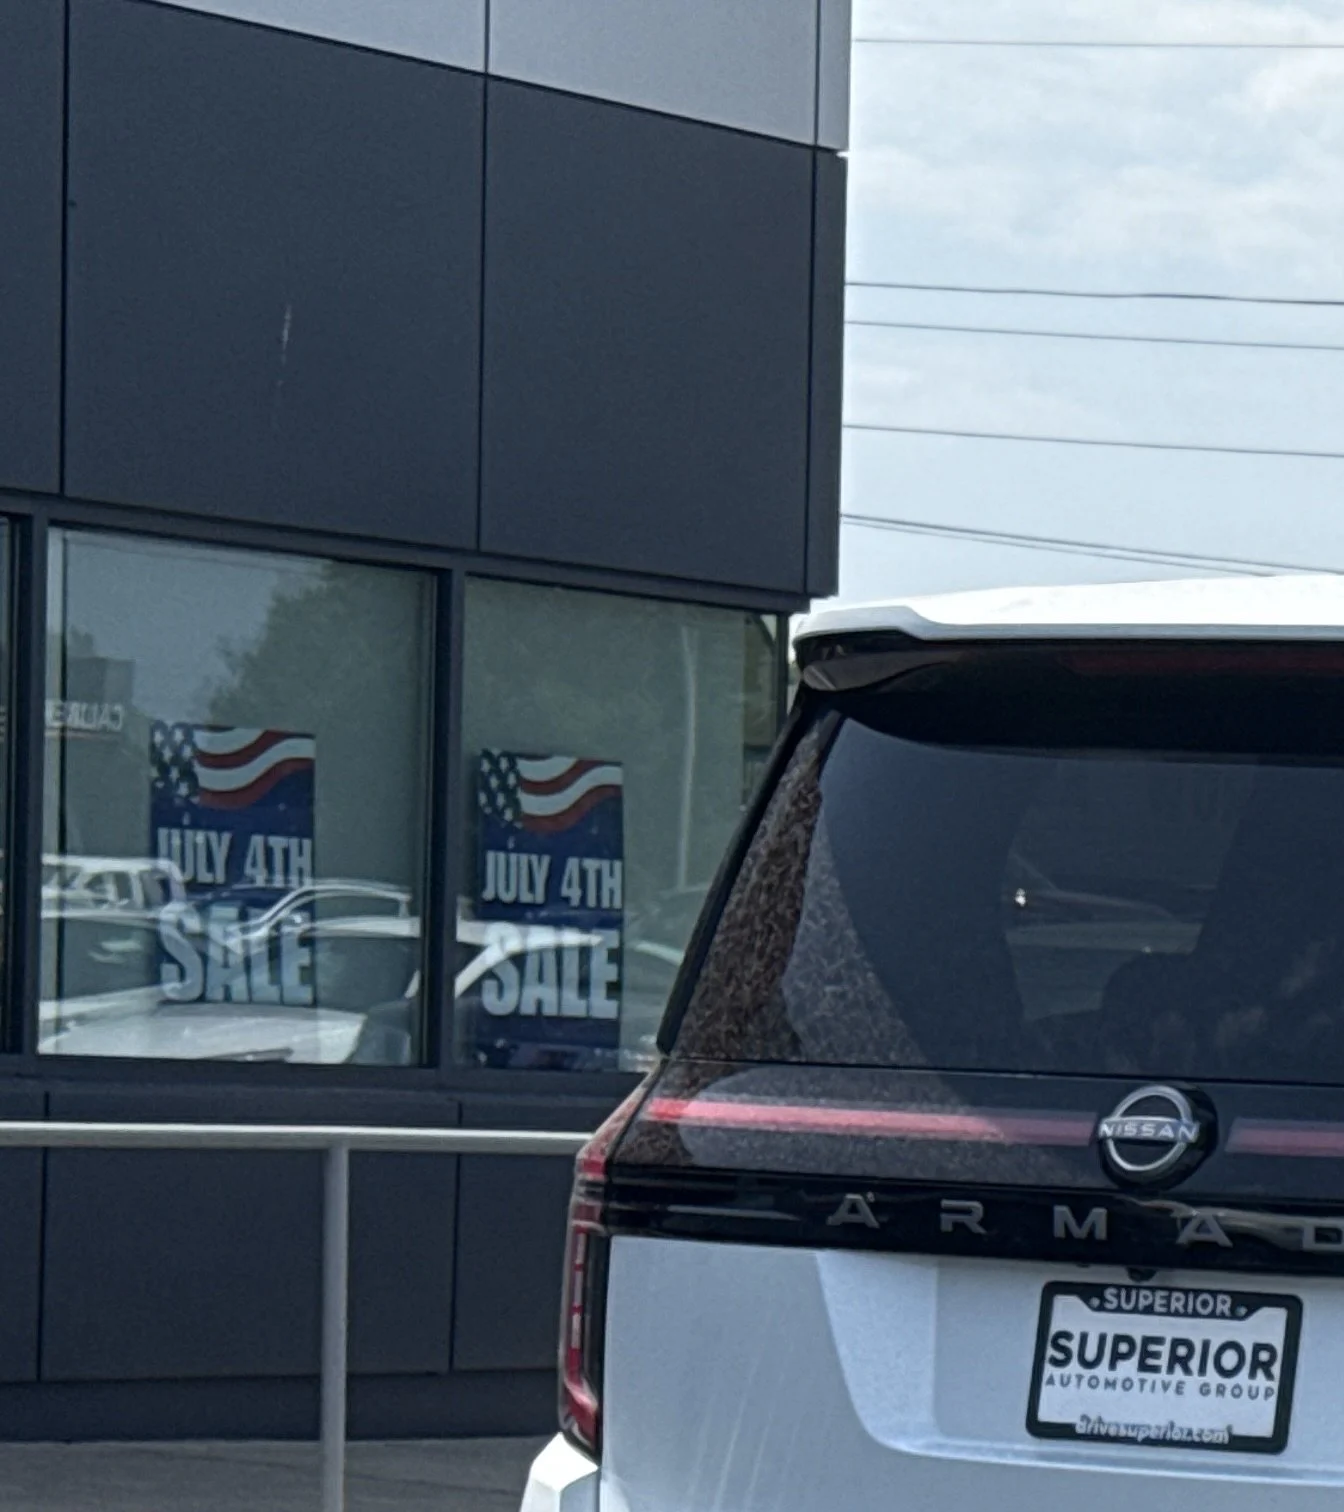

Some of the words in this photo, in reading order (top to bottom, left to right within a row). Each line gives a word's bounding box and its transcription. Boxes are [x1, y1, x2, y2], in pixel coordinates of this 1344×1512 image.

[157, 827, 232, 885] JULY
[245, 834, 313, 888] 4TH
[481, 851, 551, 904] JULY
[560, 856, 623, 910] 4TH
[160, 902, 314, 1005] SALE
[481, 921, 620, 1019] SALE
[1099, 1121, 1198, 1141] NISSAN
[1102, 1287, 1232, 1317] SUPERIOR
[1048, 1330, 1279, 1382] SUPERIOR
[1045, 1373, 1186, 1396] AUTOMOTIVE
[1199, 1382, 1275, 1401] GROUP
[1075, 1414, 1231, 1445] drivesuperior.com
